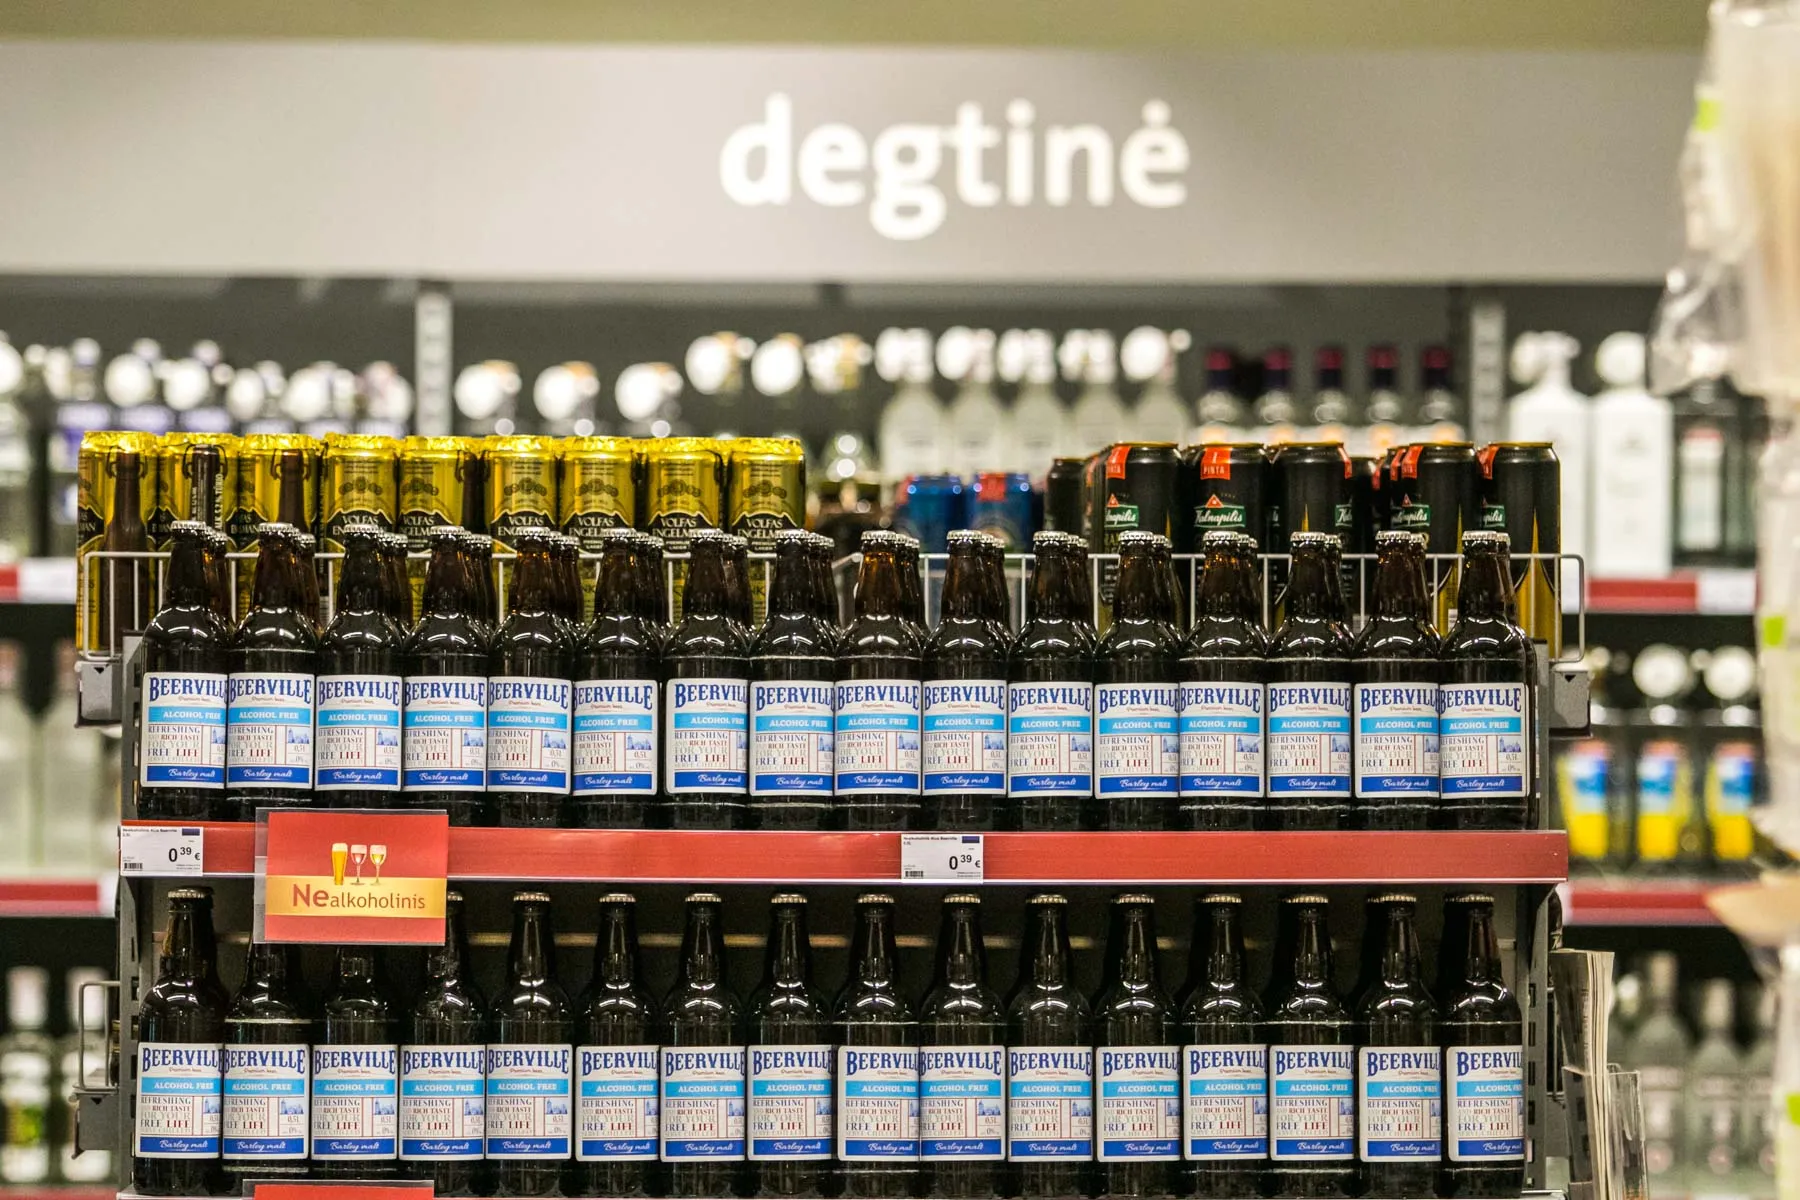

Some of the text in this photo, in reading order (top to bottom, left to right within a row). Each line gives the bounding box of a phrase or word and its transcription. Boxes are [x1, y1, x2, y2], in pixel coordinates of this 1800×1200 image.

[719, 92, 1191, 240] degtinė
[578, 517, 615, 526] VOLFAS
[660, 518, 697, 527] VOLFAS
[746, 519, 784, 528] VOLFAS
[229, 678, 311, 704] BEERVILLE
[319, 681, 399, 706] BEERVILLE
[404, 683, 484, 707] BEERVILLE
[490, 683, 568, 709] BEERVILLE
[838, 686, 919, 710] BEERVILLE
[924, 686, 1005, 710] BEERVILLE
[1011, 688, 1091, 712] BEERVILLE
[1181, 688, 1260, 712] BEERVILLE
[414, 715, 452, 723] ALCOHOL
[580, 719, 615, 727] ALCOHOL
[935, 718, 973, 726] ALCOHOL
[1021, 720, 1059, 728] ALCOHOL
[1113, 721, 1152, 729] ALCOHOL
[1189, 720, 1225, 728] ALCOHOL
[168, 846, 201, 863] 0 39 €
[949, 854, 981, 870] 0 39 €
[292, 883, 426, 909] Nealkoholinis
[315, 1051, 395, 1075] BEERVILLE
[404, 1051, 485, 1075] BEERVILLE
[488, 1050, 569, 1074] BEERVILLE
[232, 1083, 268, 1091] ALCOHOL
[414, 1084, 453, 1092] ALCOHOL
[597, 1084, 636, 1092] ALCOHOL
[678, 1085, 718, 1093] ALCOHOL
[766, 1084, 806, 1092] ALCOHOL
[862, 1085, 901, 1093] ALCOHOL
[1022, 1085, 1061, 1093] ALCOHOL
[1118, 1085, 1157, 1093] ALCOHOL
[1475, 1084, 1511, 1092] ALCOHOL
